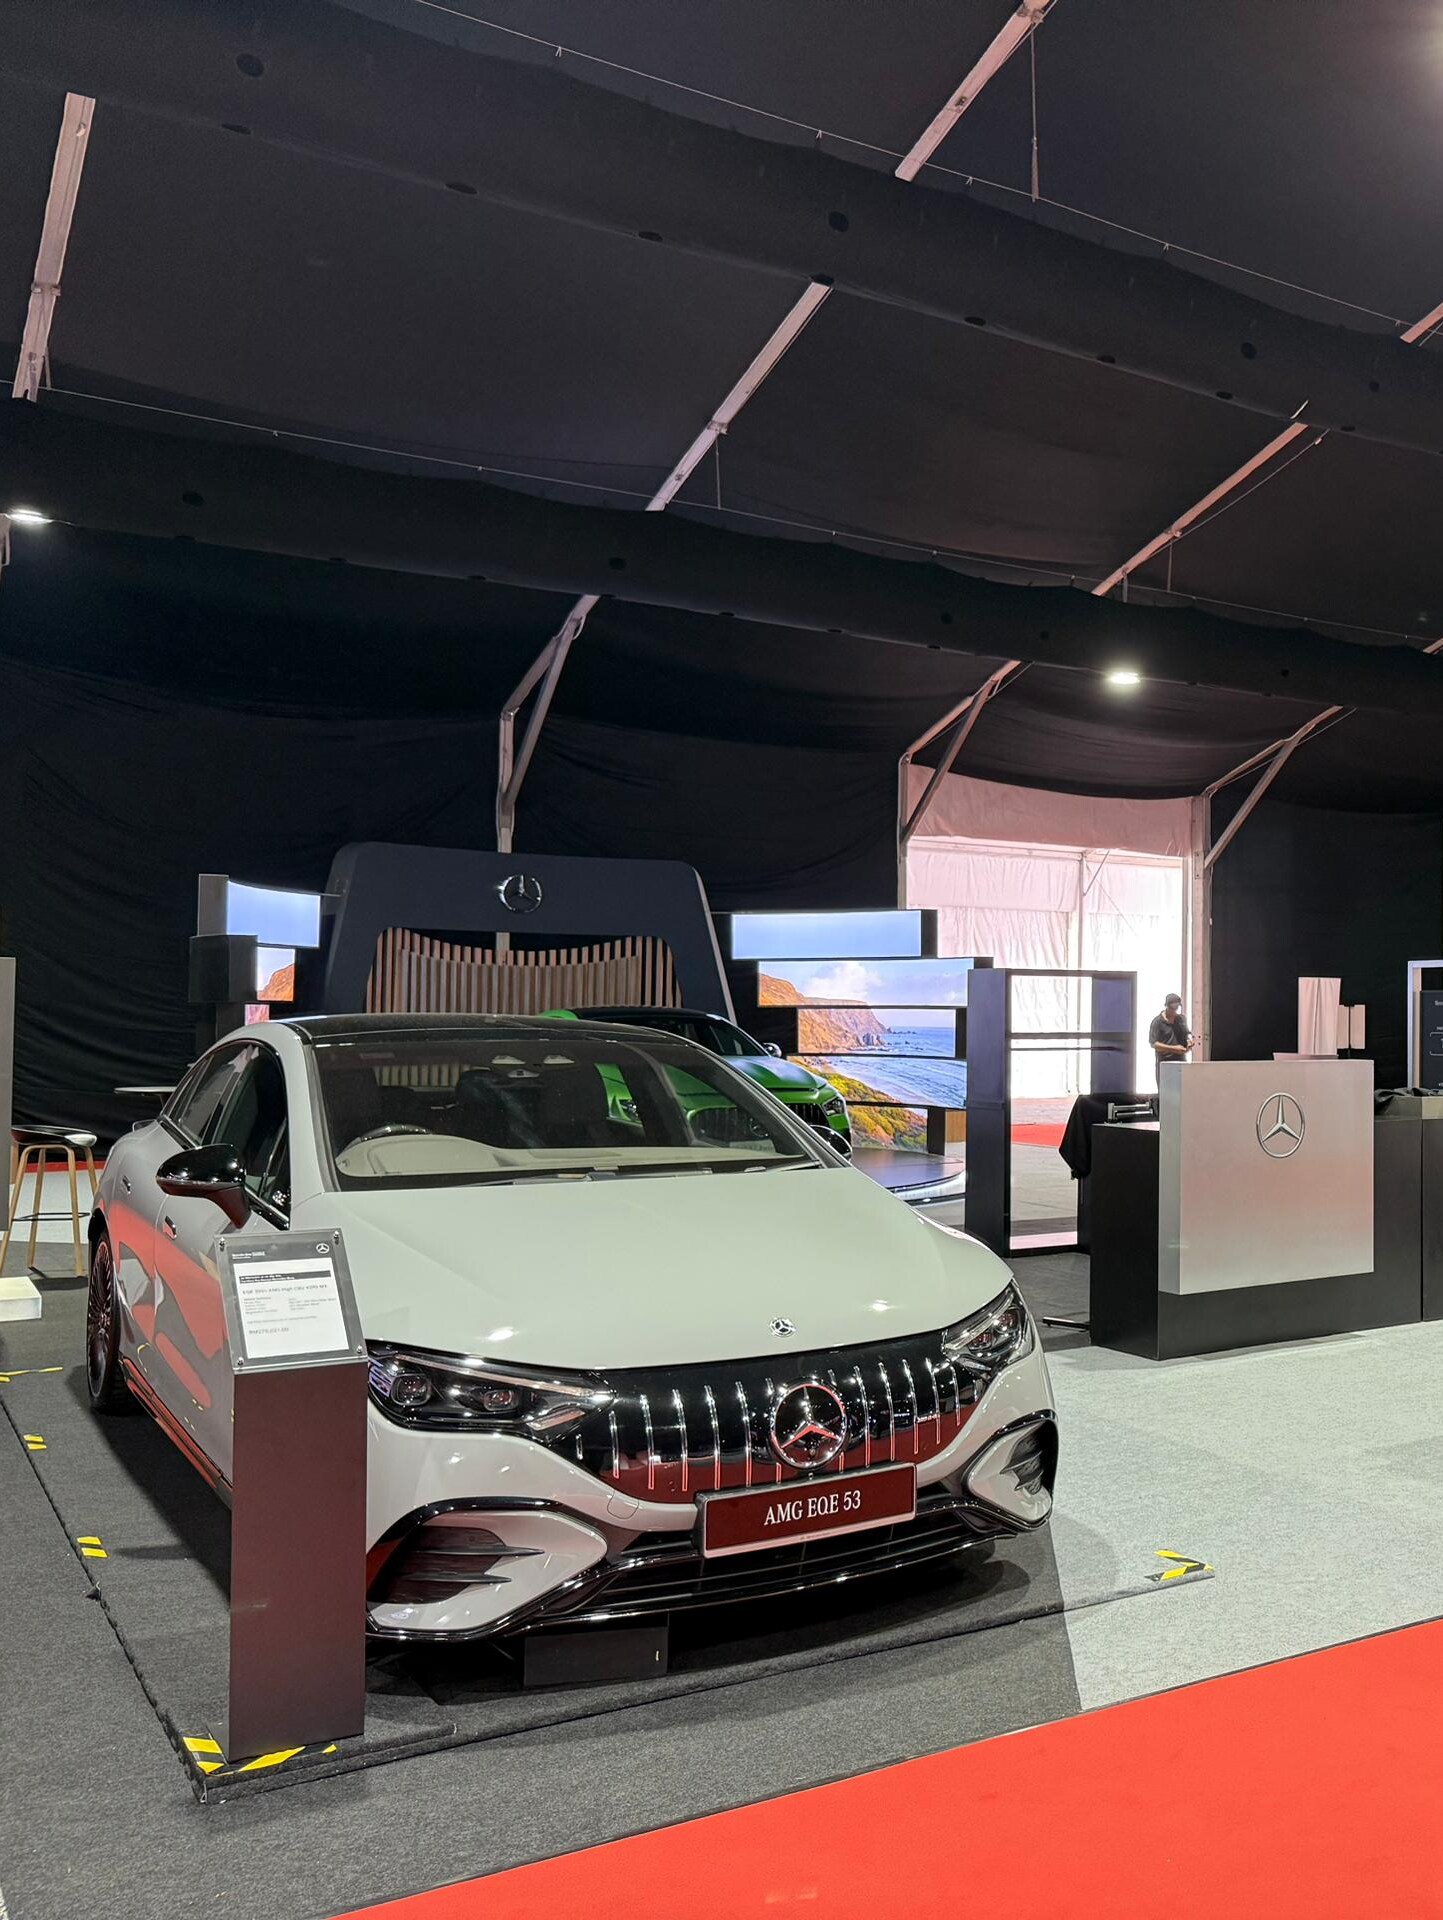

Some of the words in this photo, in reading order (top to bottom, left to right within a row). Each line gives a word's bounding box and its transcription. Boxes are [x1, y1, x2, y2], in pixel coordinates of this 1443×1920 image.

[764, 1500, 803, 1526] AMG
[807, 1493, 839, 1518] EQE
[843, 1489, 861, 1511] 53
